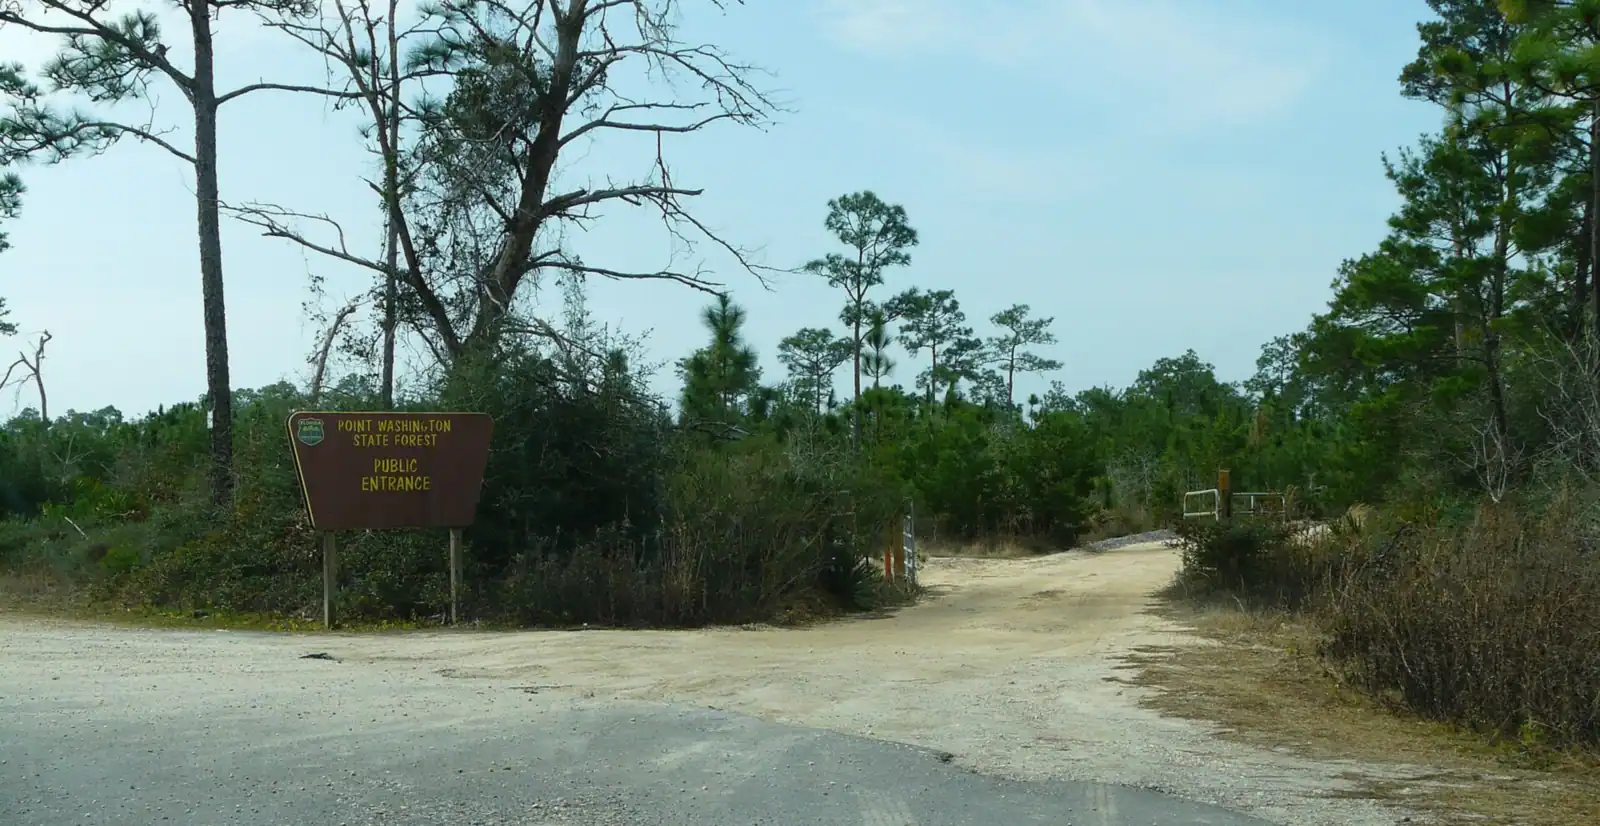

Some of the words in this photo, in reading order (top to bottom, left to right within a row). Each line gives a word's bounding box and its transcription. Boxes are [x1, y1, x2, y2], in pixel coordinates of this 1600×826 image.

[338, 419, 373, 432] POINT
[378, 419, 451, 432] WASHINGTON
[353, 434, 389, 447] STATE
[395, 434, 437, 447] FOREST
[374, 458, 417, 473] PUBLIC
[361, 476, 431, 492] ENTRANCE
